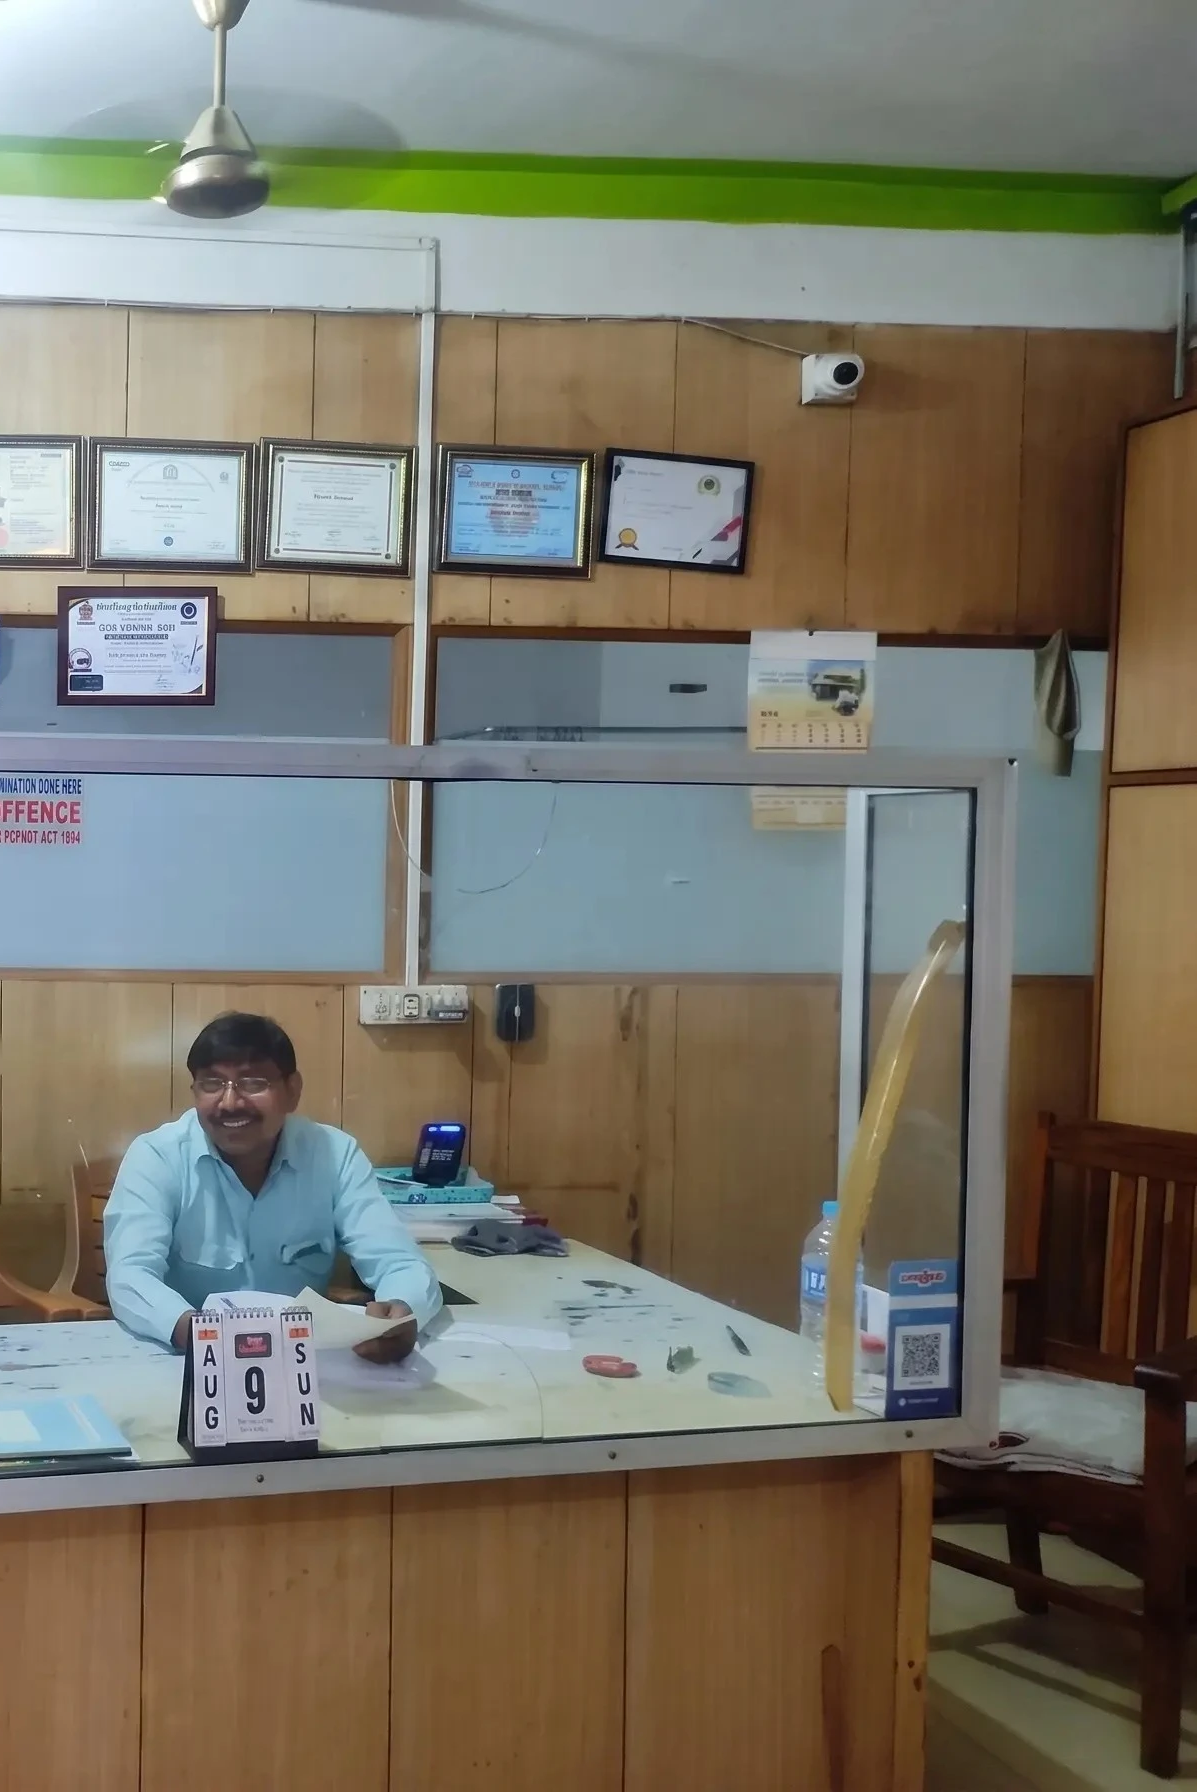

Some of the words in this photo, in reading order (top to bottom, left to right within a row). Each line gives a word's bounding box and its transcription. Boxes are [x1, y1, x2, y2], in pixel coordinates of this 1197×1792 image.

[38, 778, 60, 794] DONE
[62, 779, 82, 794] HERE
[41, 831, 58, 844] ACT
[203, 1344, 218, 1430] AUG
[244, 1366, 266, 1415] 9
[294, 1342, 315, 1426] SUN
